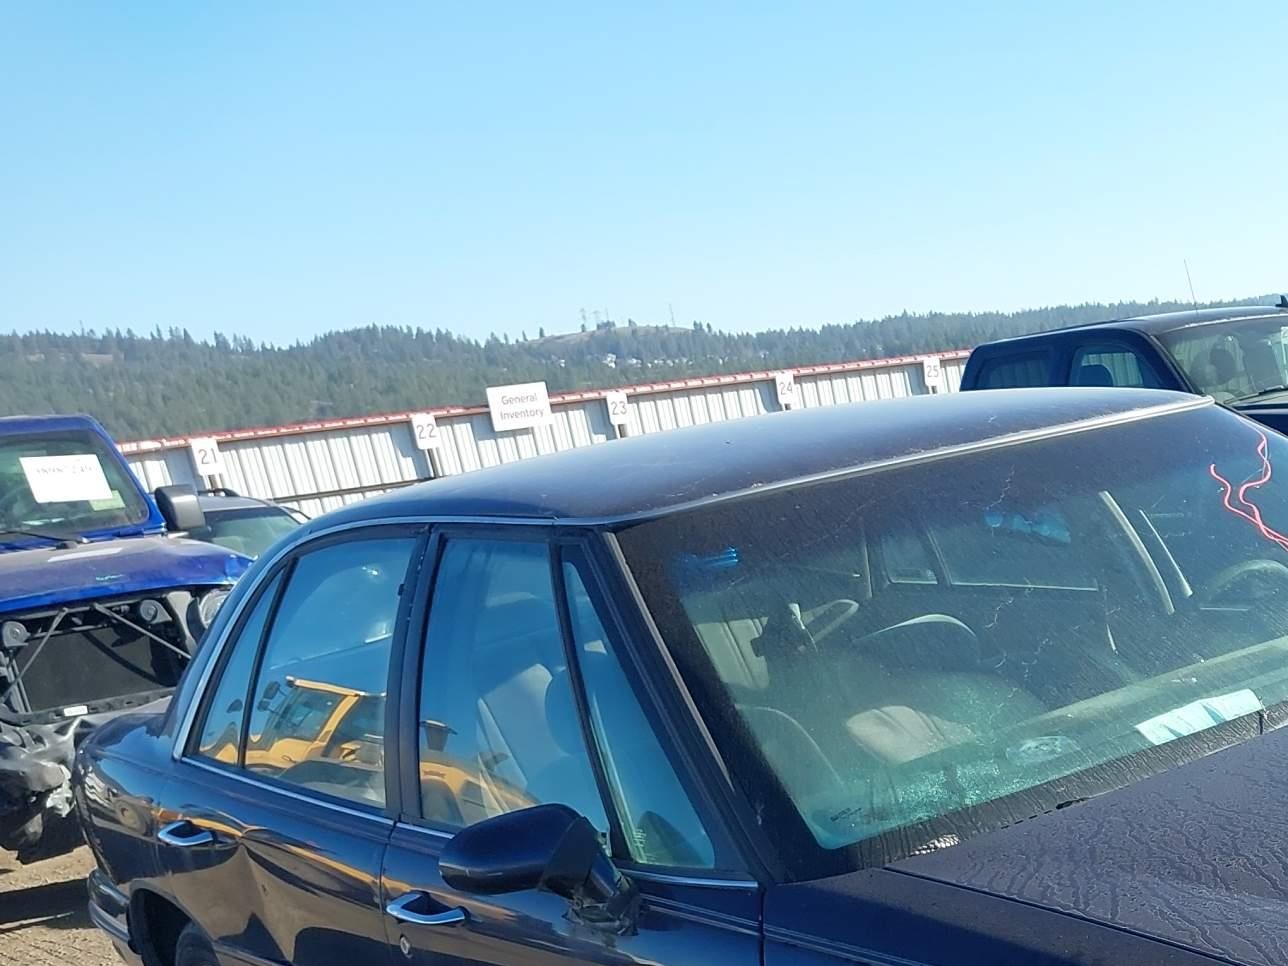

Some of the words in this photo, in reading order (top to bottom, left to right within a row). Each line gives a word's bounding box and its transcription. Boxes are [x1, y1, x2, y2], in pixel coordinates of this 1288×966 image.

[927, 365, 939, 377] 25
[779, 381, 793, 395] 24
[501, 393, 537, 405] General
[500, 409, 544, 420] Inventory
[610, 401, 627, 415] 23
[416, 424, 437, 439] 22
[198, 448, 217, 464] 21
